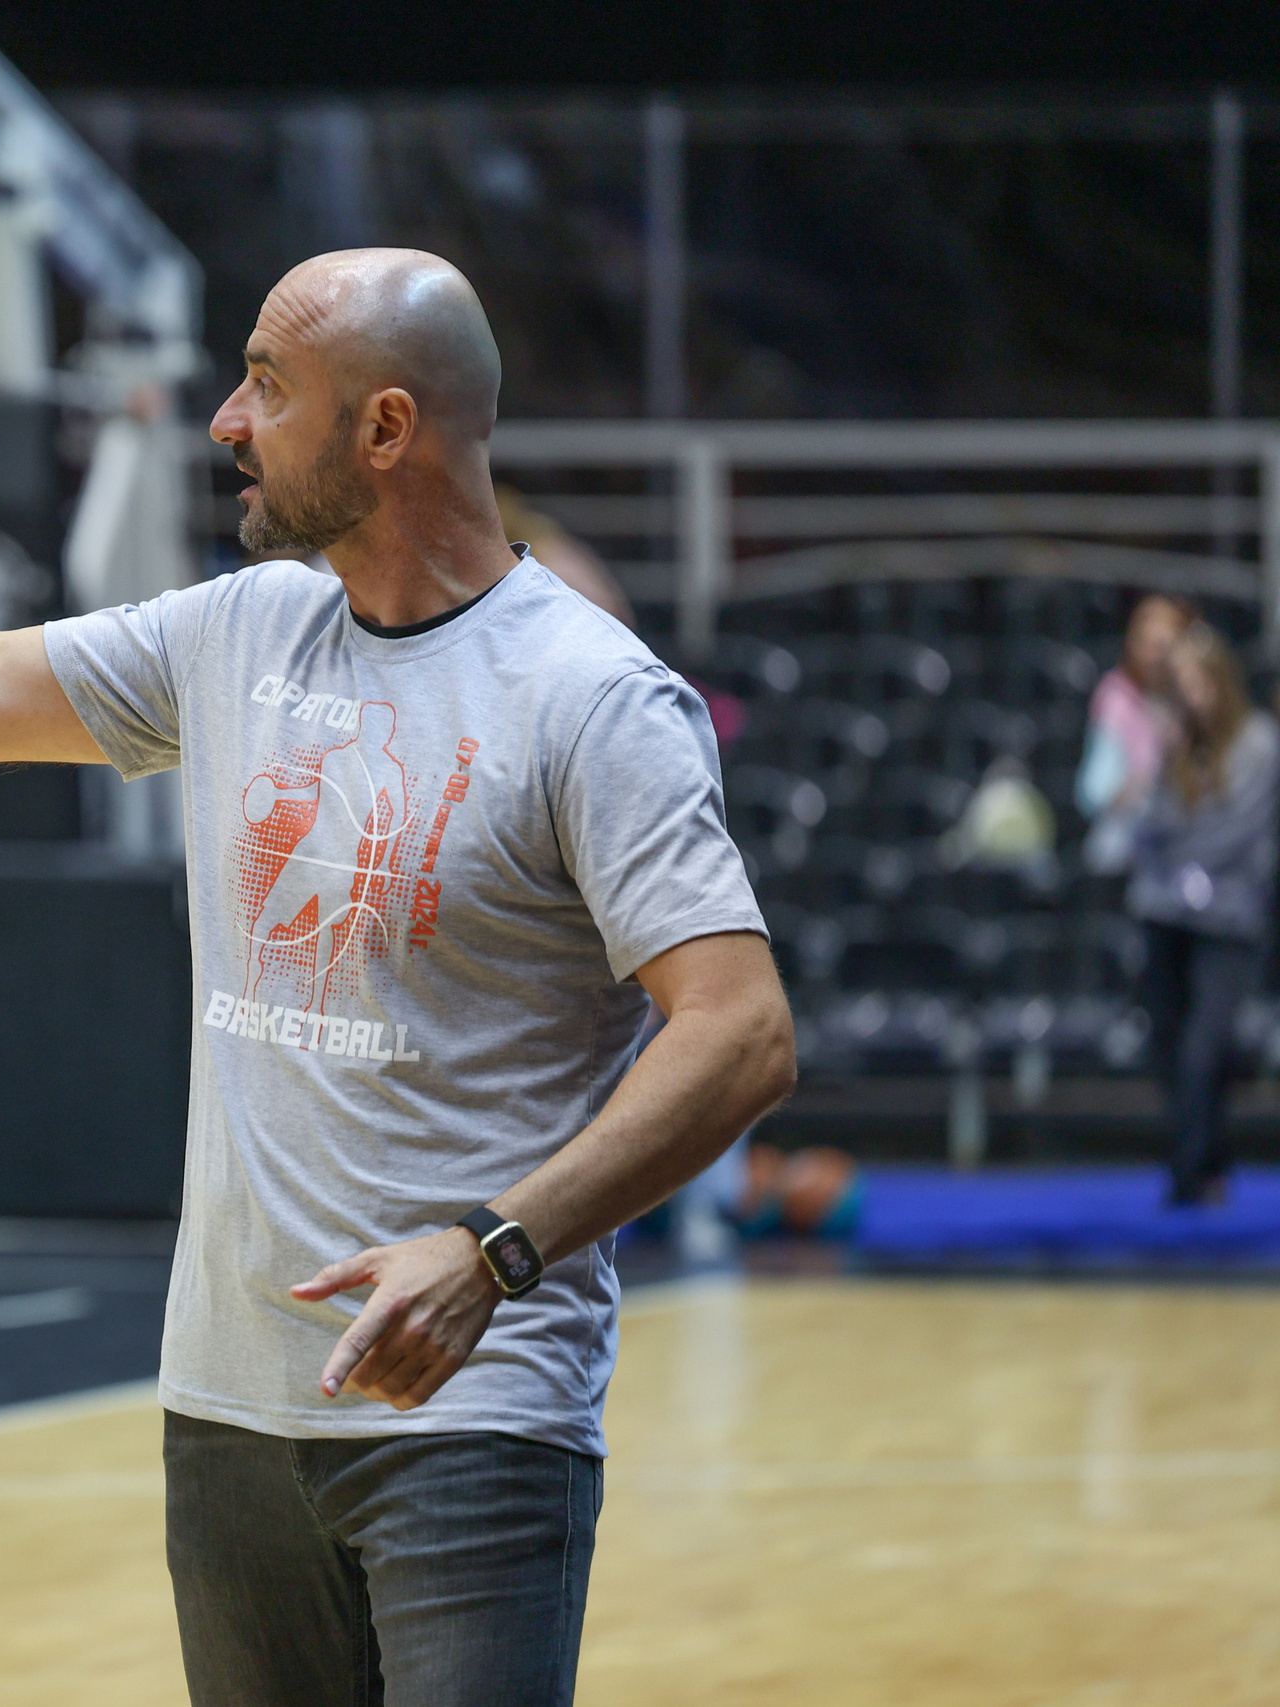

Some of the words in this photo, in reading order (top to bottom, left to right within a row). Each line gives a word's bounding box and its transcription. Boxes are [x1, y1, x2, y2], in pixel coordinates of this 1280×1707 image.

[442, 737, 480, 803] 07-08
[409, 878, 441, 937] 2024
[202, 989, 420, 1062] BASKETBALL
